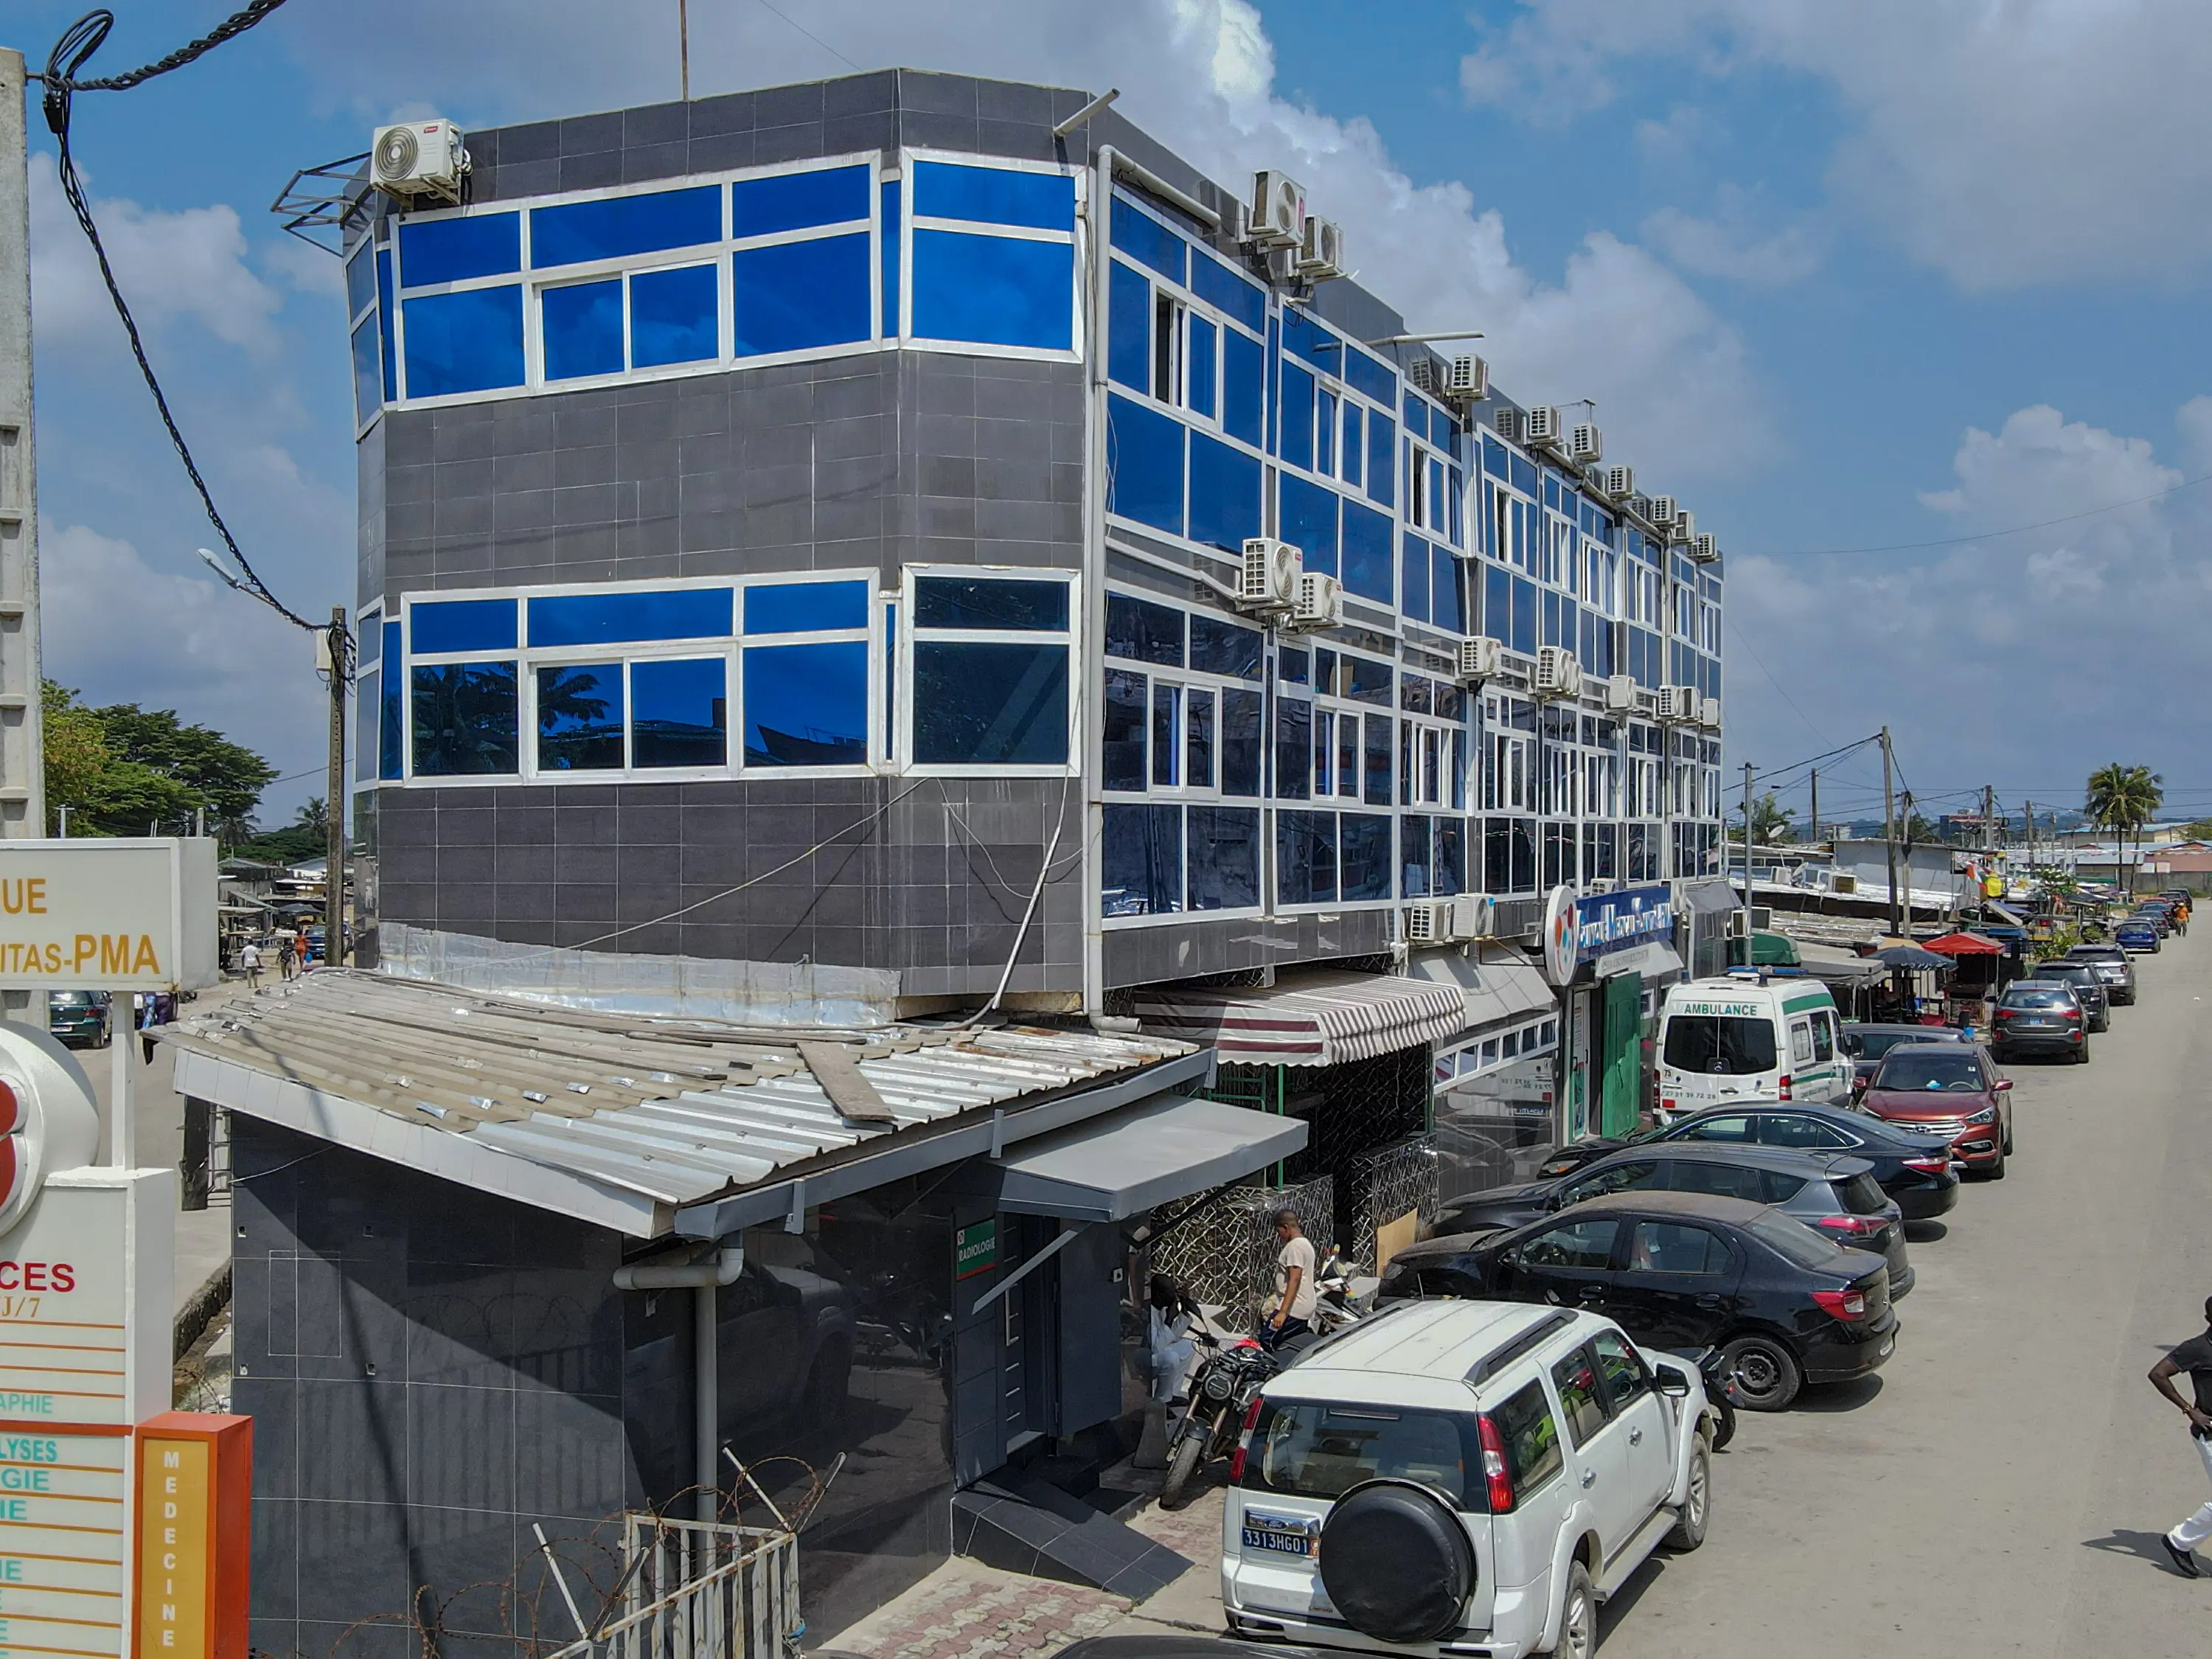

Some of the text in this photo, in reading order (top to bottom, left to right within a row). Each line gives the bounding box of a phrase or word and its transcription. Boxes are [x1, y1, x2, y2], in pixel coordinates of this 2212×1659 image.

[2, 878, 47, 914] UE
[0, 934, 161, 974] ITAS-PMA
[1684, 1003, 1757, 1017] AMBULANCE
[959, 1236, 995, 1262] RADIOLOGIE
[0, 1261, 75, 1293] CES
[1, 1467, 51, 1492] GIE
[162, 1450, 180, 1648] MEDECINE
[1244, 1528, 1308, 1554] 3313HG01
